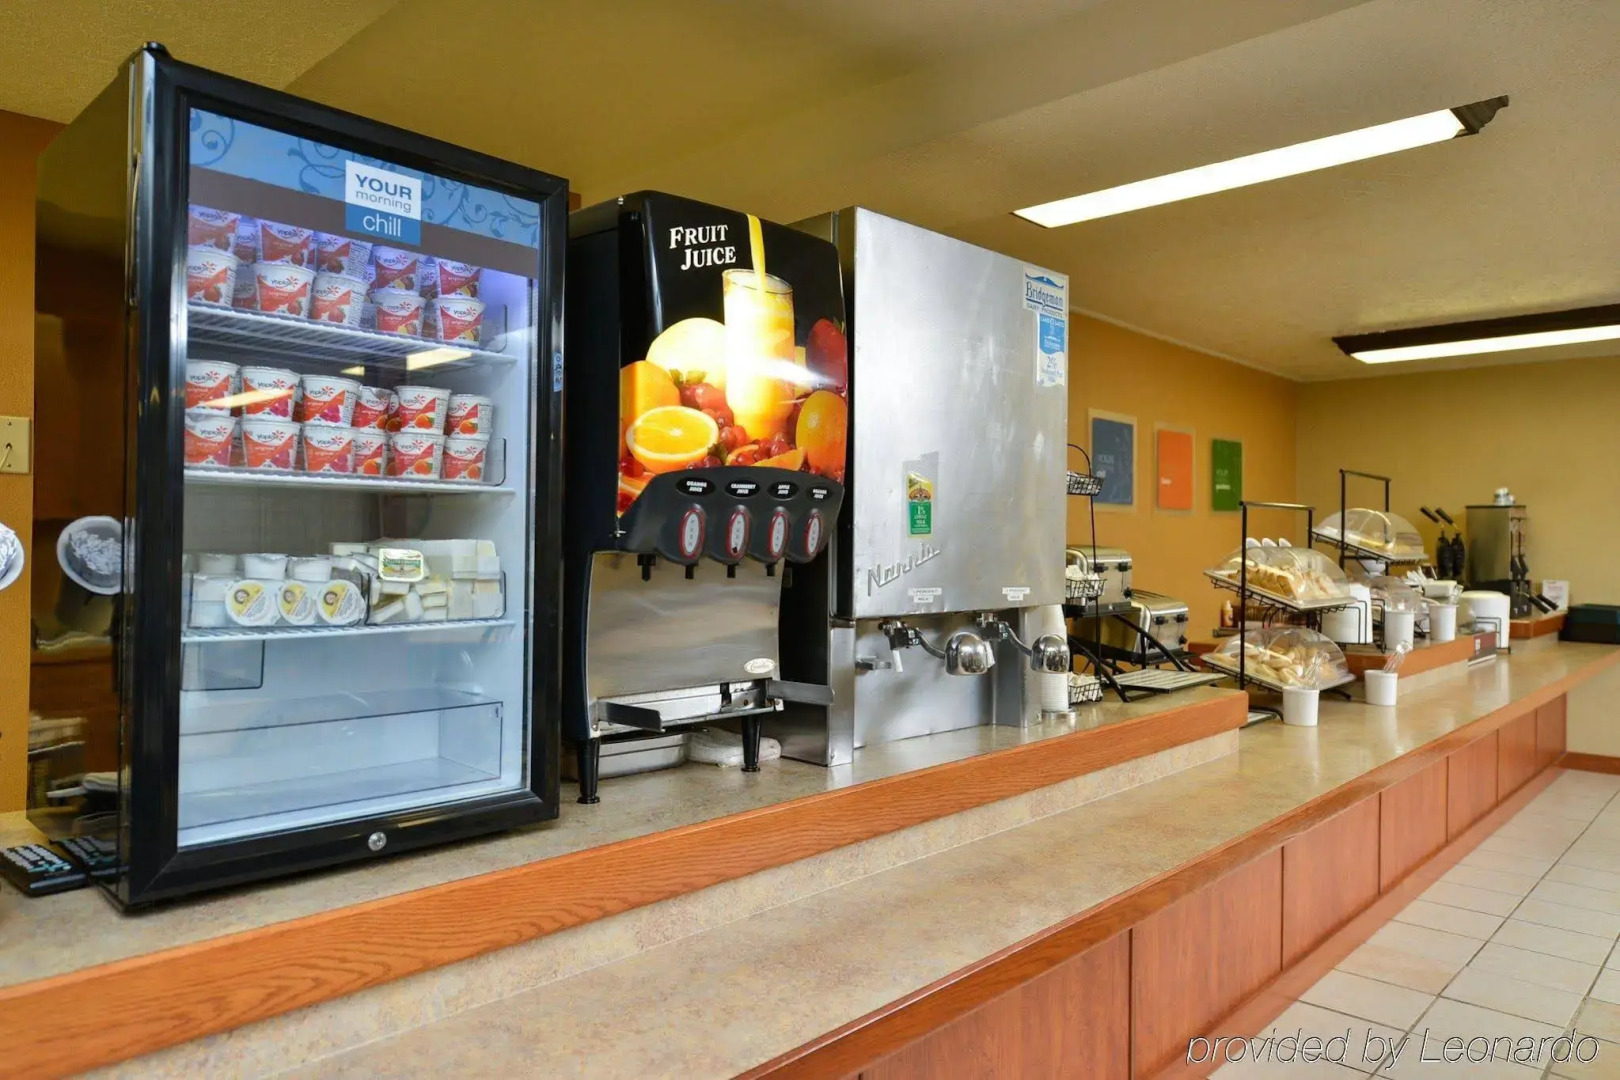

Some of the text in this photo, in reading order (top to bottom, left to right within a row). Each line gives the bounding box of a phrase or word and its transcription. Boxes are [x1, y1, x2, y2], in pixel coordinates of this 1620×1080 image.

[355, 173, 412, 200] YOUR
[355, 190, 412, 213] morning
[363, 212, 402, 237] chill
[669, 224, 729, 249] FRUIT
[681, 246, 737, 271] JUICE
[1025, 281, 1064, 308] Bridgeman
[686, 480, 708, 488] ORANGE
